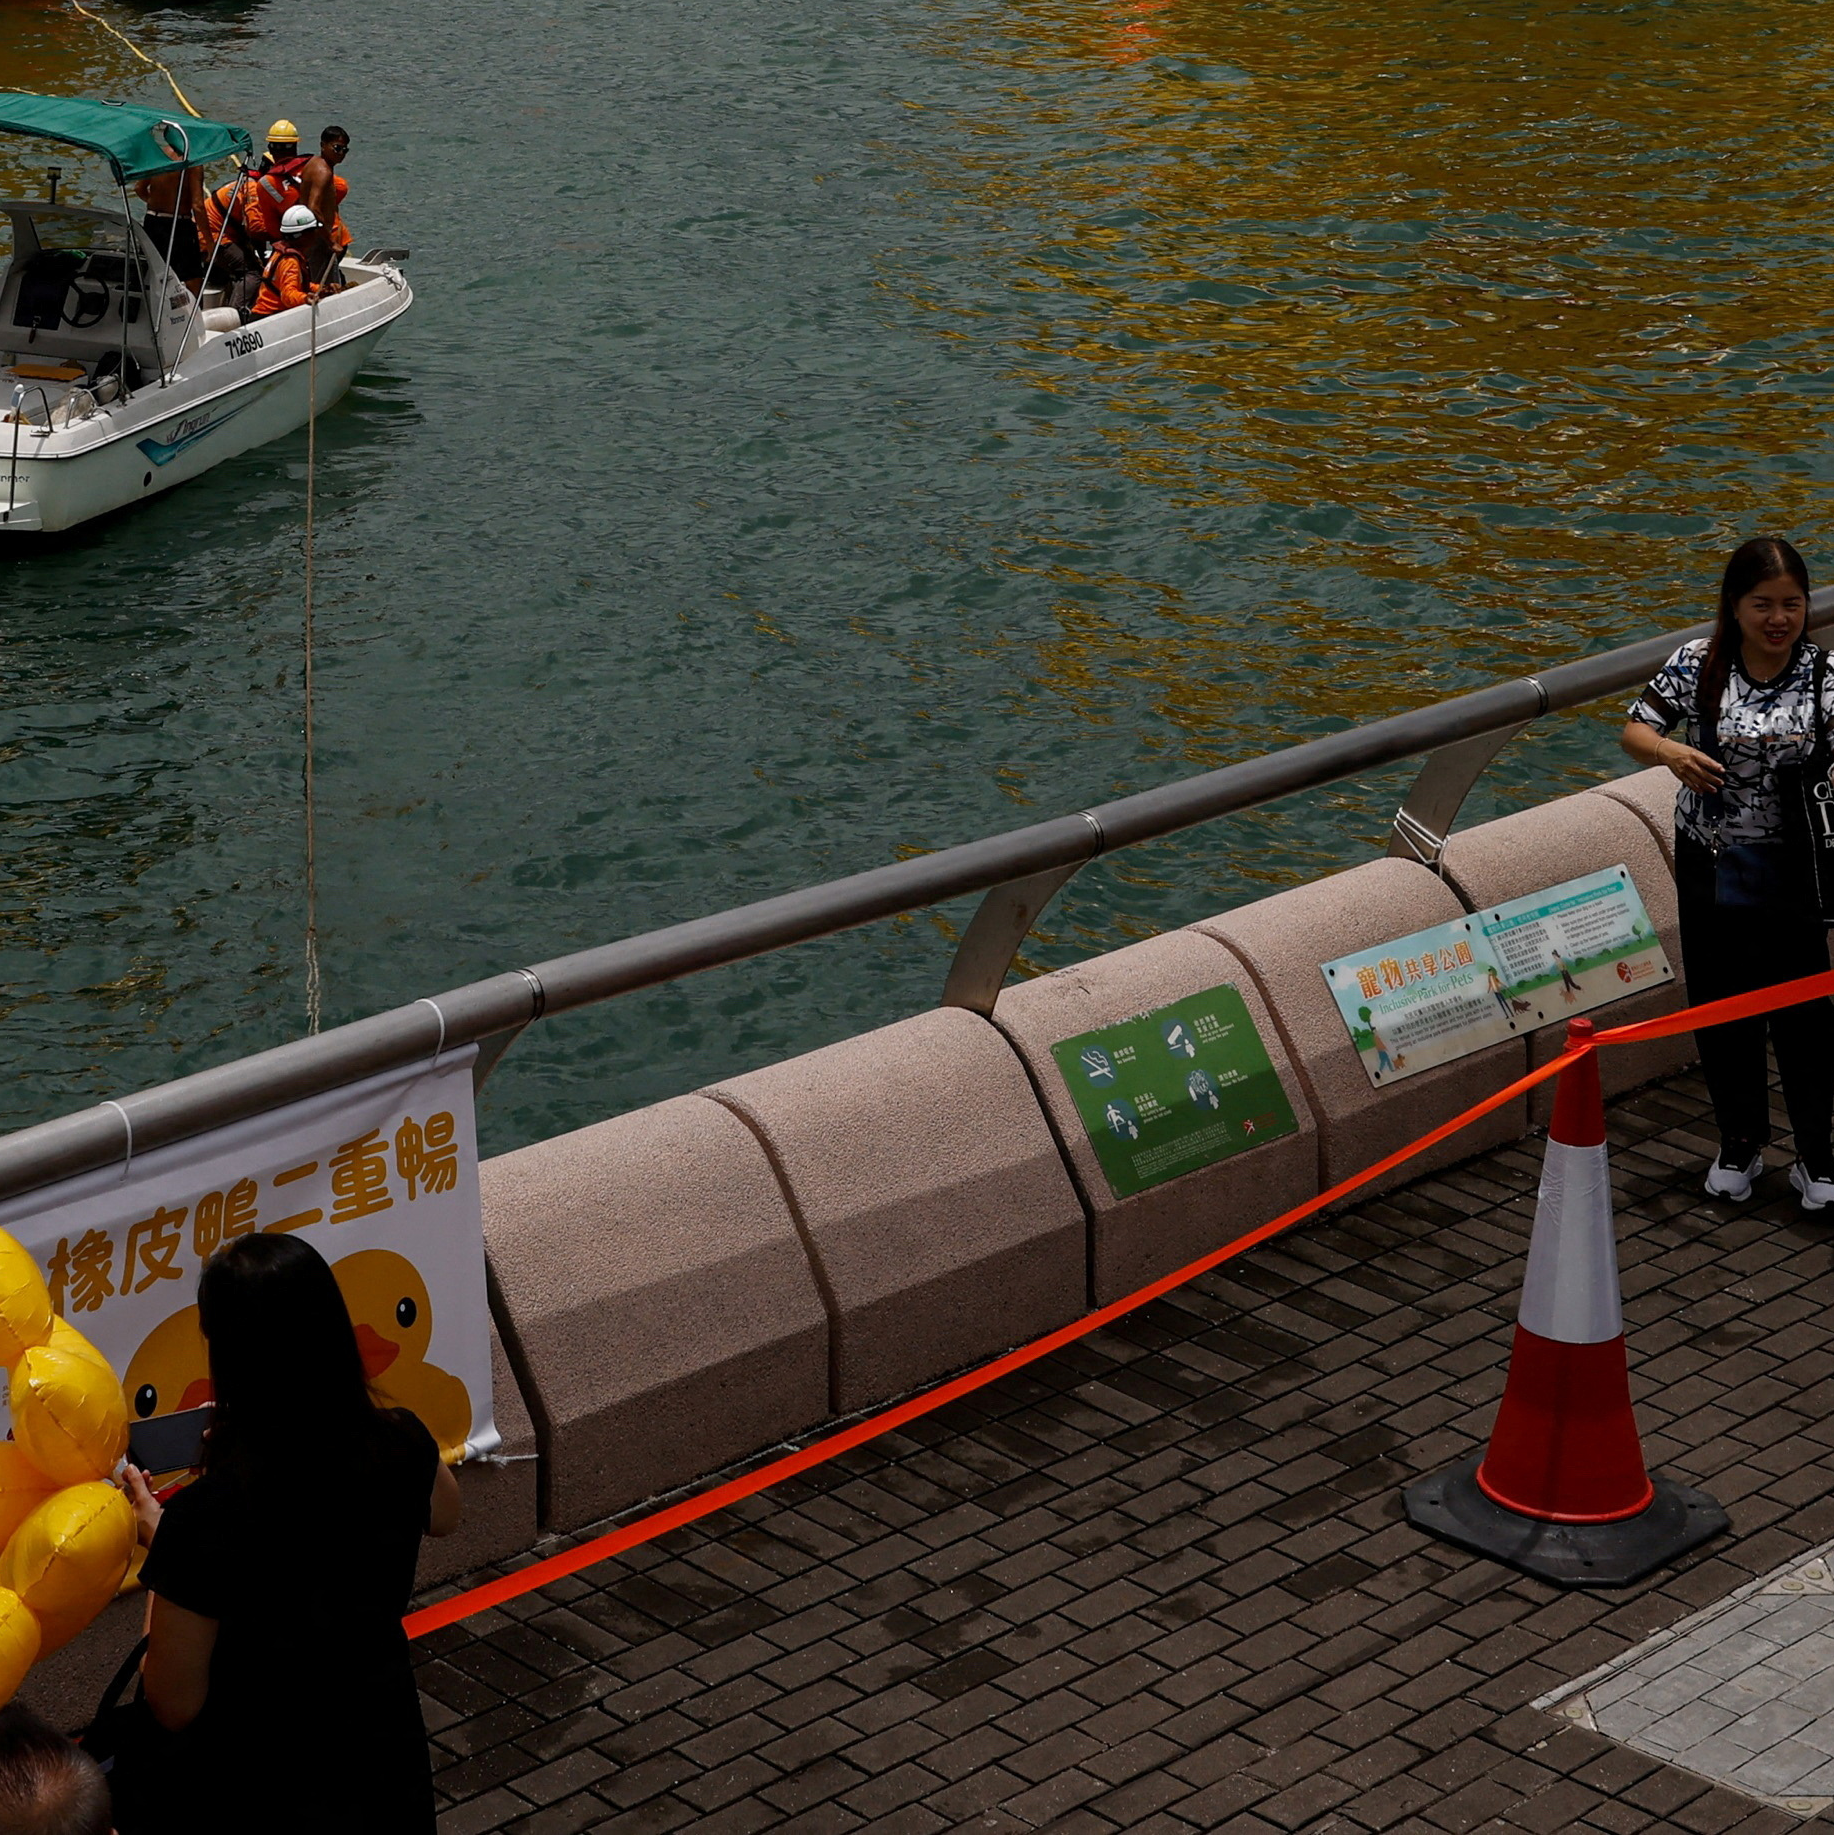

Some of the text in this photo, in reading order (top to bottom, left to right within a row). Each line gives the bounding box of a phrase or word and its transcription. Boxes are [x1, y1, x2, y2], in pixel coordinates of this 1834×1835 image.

[225, 331, 264, 359] 712690
[1356, 941, 1474, 1000] 寵物共享公園
[1379, 991, 1417, 1015] Inclusive
[1417, 986, 1438, 1002] Park
[1438, 982, 1451, 994] for
[1450, 971, 1474, 988] Pets
[47, 1111, 458, 1314] 橡皮鴨二重暢
